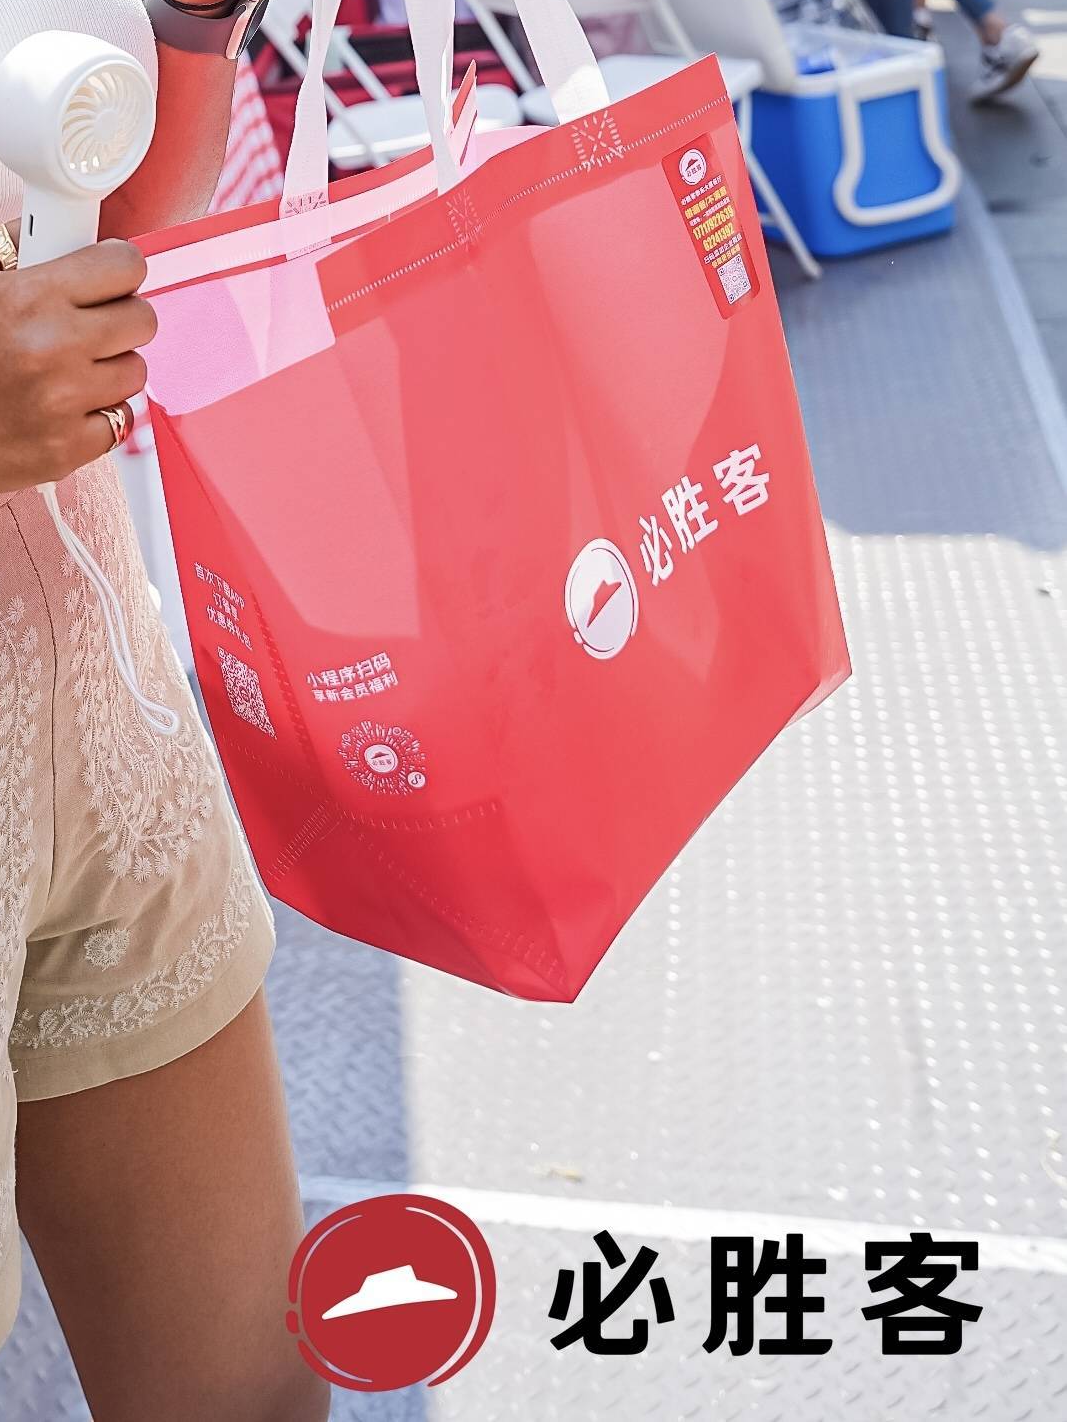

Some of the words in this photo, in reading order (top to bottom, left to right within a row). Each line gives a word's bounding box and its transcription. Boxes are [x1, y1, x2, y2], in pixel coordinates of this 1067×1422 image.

[638, 442, 771, 587] 必胜客
[306, 651, 392, 689] 小程序扫码
[311, 669, 400, 703] 享新会员福利
